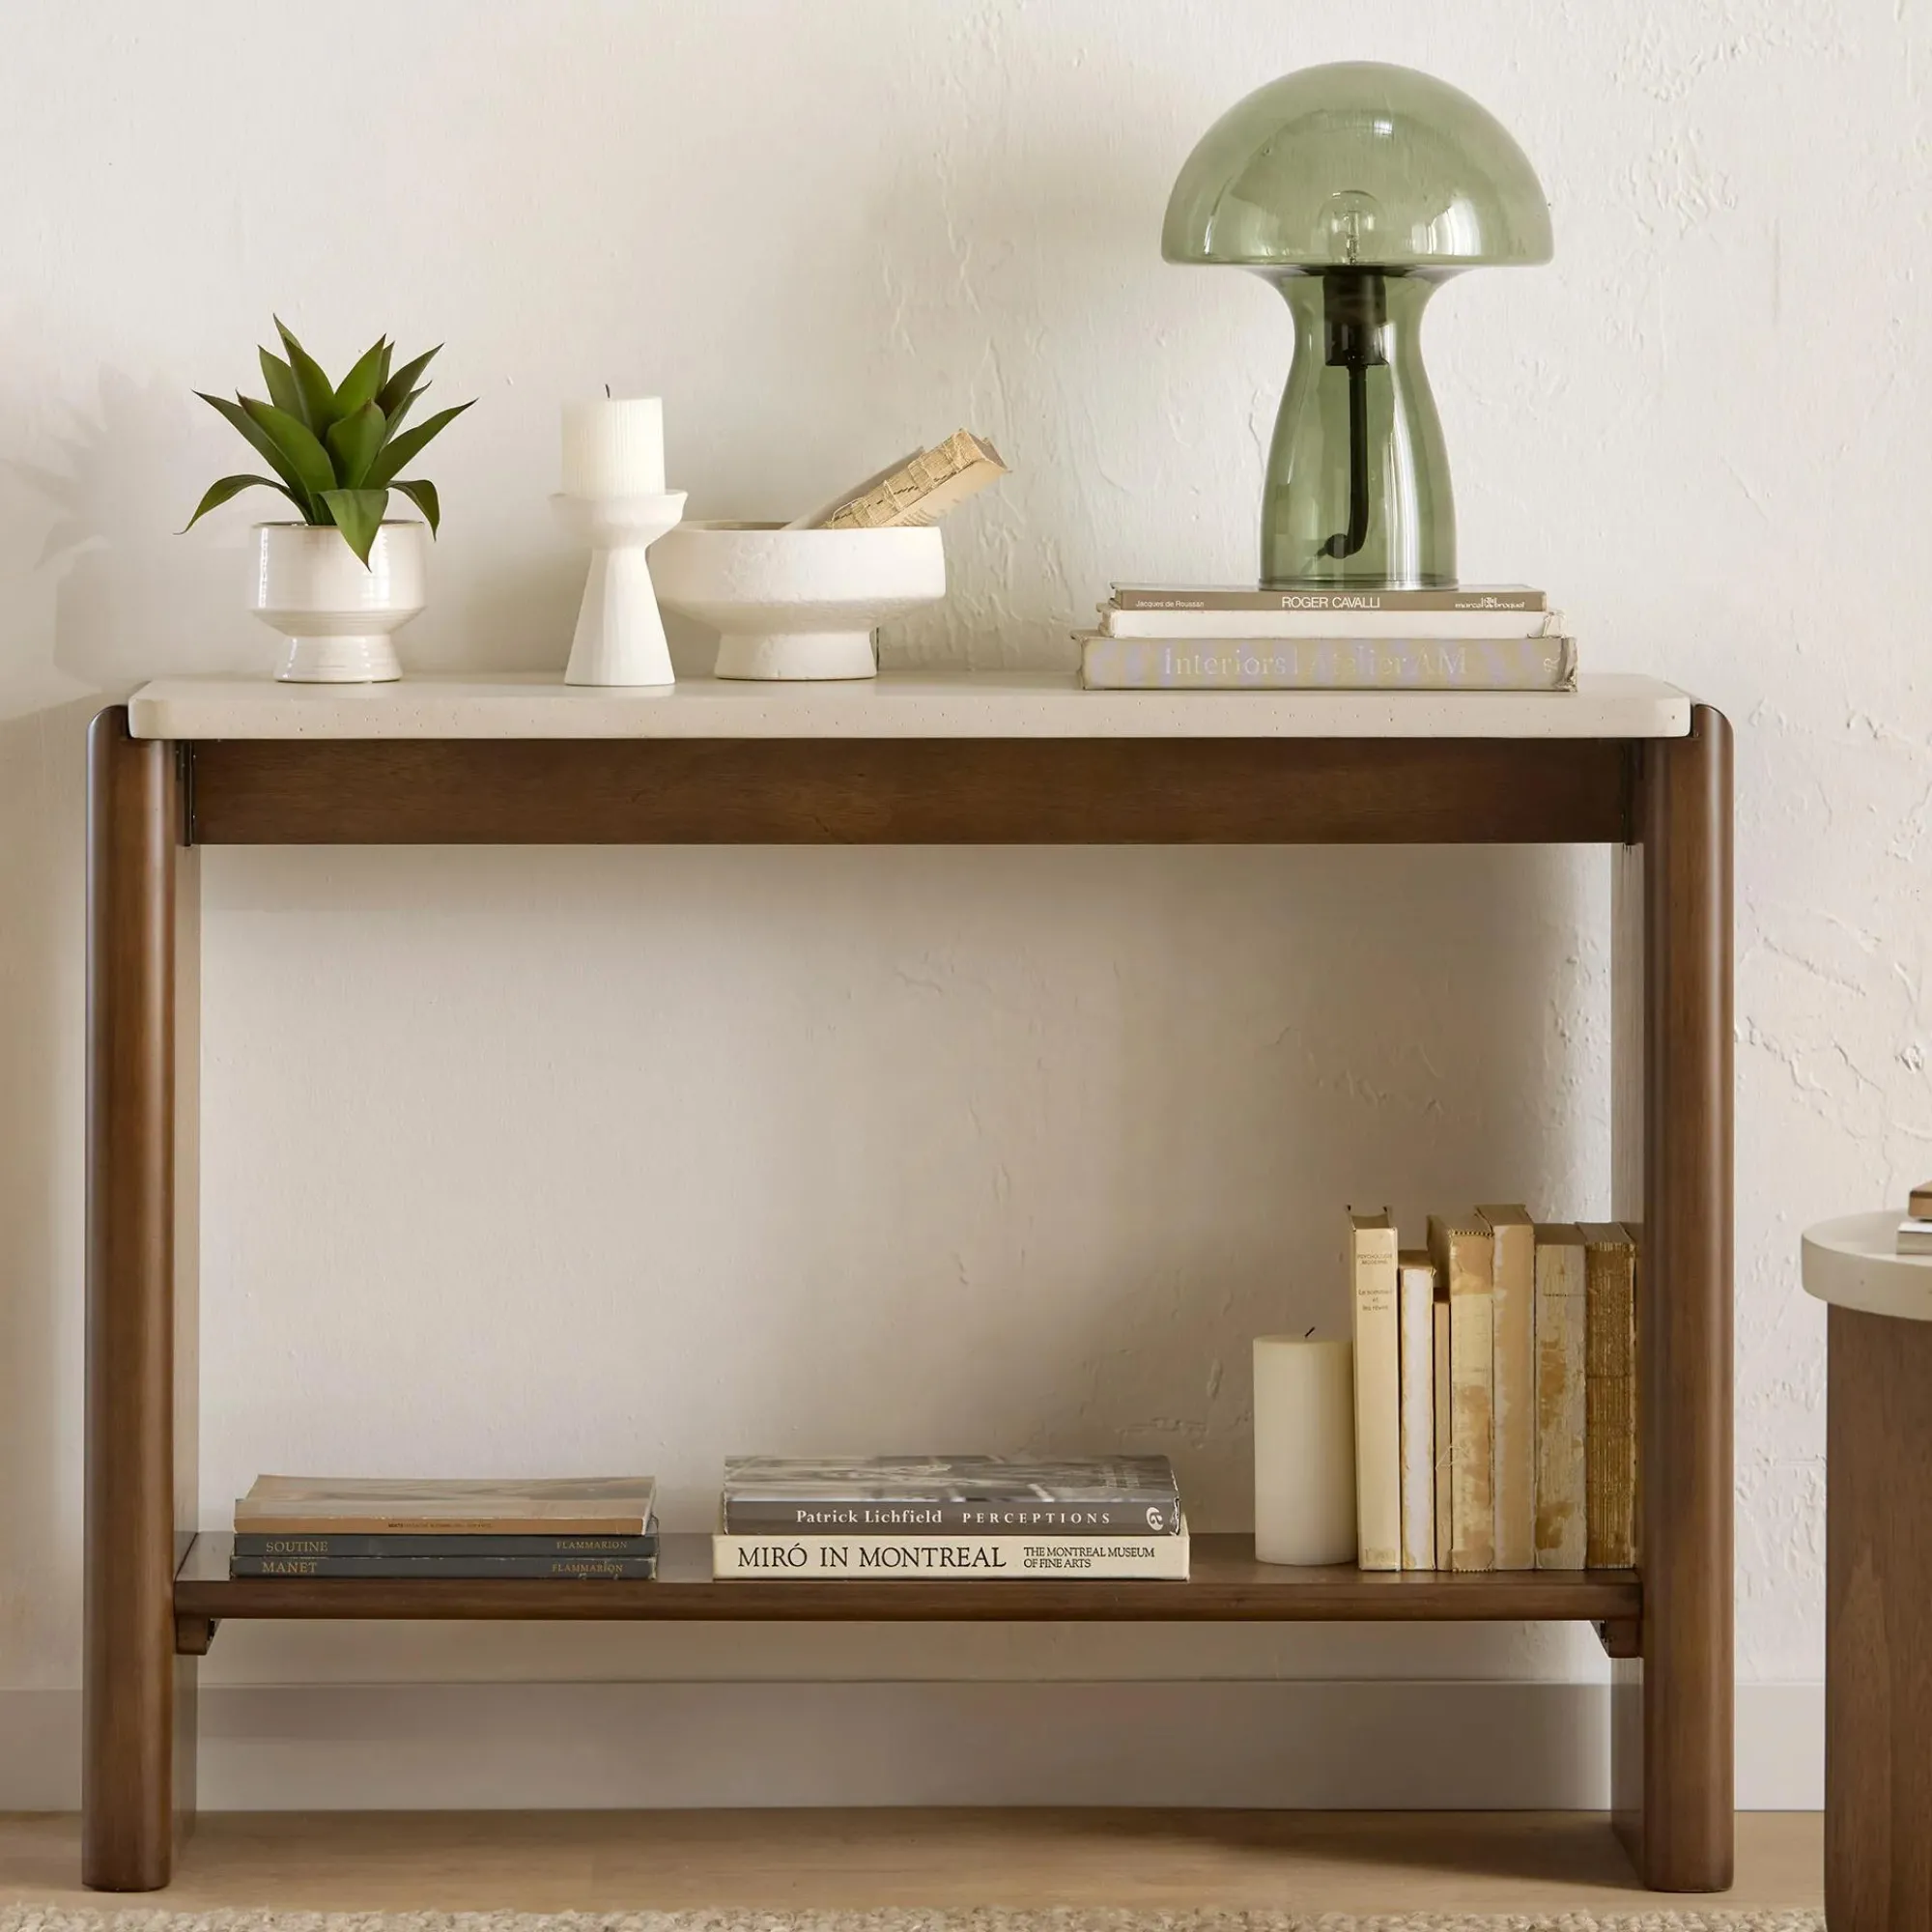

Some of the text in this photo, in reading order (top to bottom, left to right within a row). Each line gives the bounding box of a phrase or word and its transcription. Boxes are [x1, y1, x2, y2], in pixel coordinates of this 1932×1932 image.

[1282, 596, 1380, 608] ROGER CAVALLI
[1165, 647, 1287, 674] Interiors
[797, 1510, 1110, 1523] Patrick Lichfield PERCEPTIONS
[266, 1541, 328, 1552] SOUTINE
[556, 1541, 627, 1549] FLAMMARION
[738, 1543, 1007, 1567] MIRÓ IN MONTREAL
[1024, 1547, 1155, 1557] THE MONTREAL MUSEUM
[262, 1561, 318, 1573] MANET
[552, 1563, 623, 1573] FLAMMARION
[1024, 1558, 1092, 1568] OF FINE ARTS
